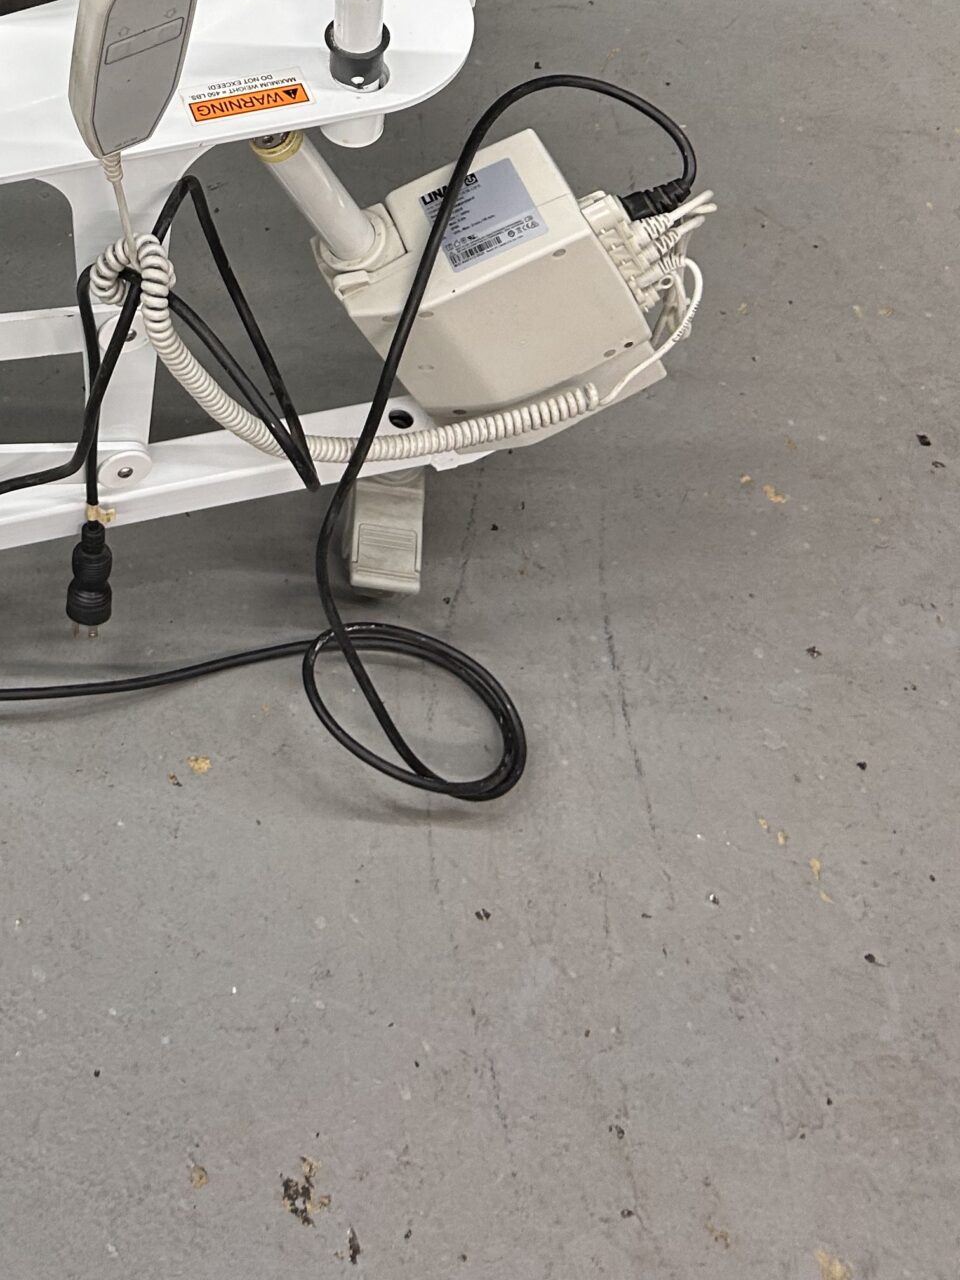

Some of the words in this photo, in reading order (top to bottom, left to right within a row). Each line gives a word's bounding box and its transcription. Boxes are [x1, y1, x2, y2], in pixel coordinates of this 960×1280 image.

[243, 77, 260, 85] NOT
[259, 76, 297, 89] MAXIMUM
[260, 74, 273, 82] DO
[229, 83, 259, 95] WEIGHT
[196, 91, 284, 116] WARNING
